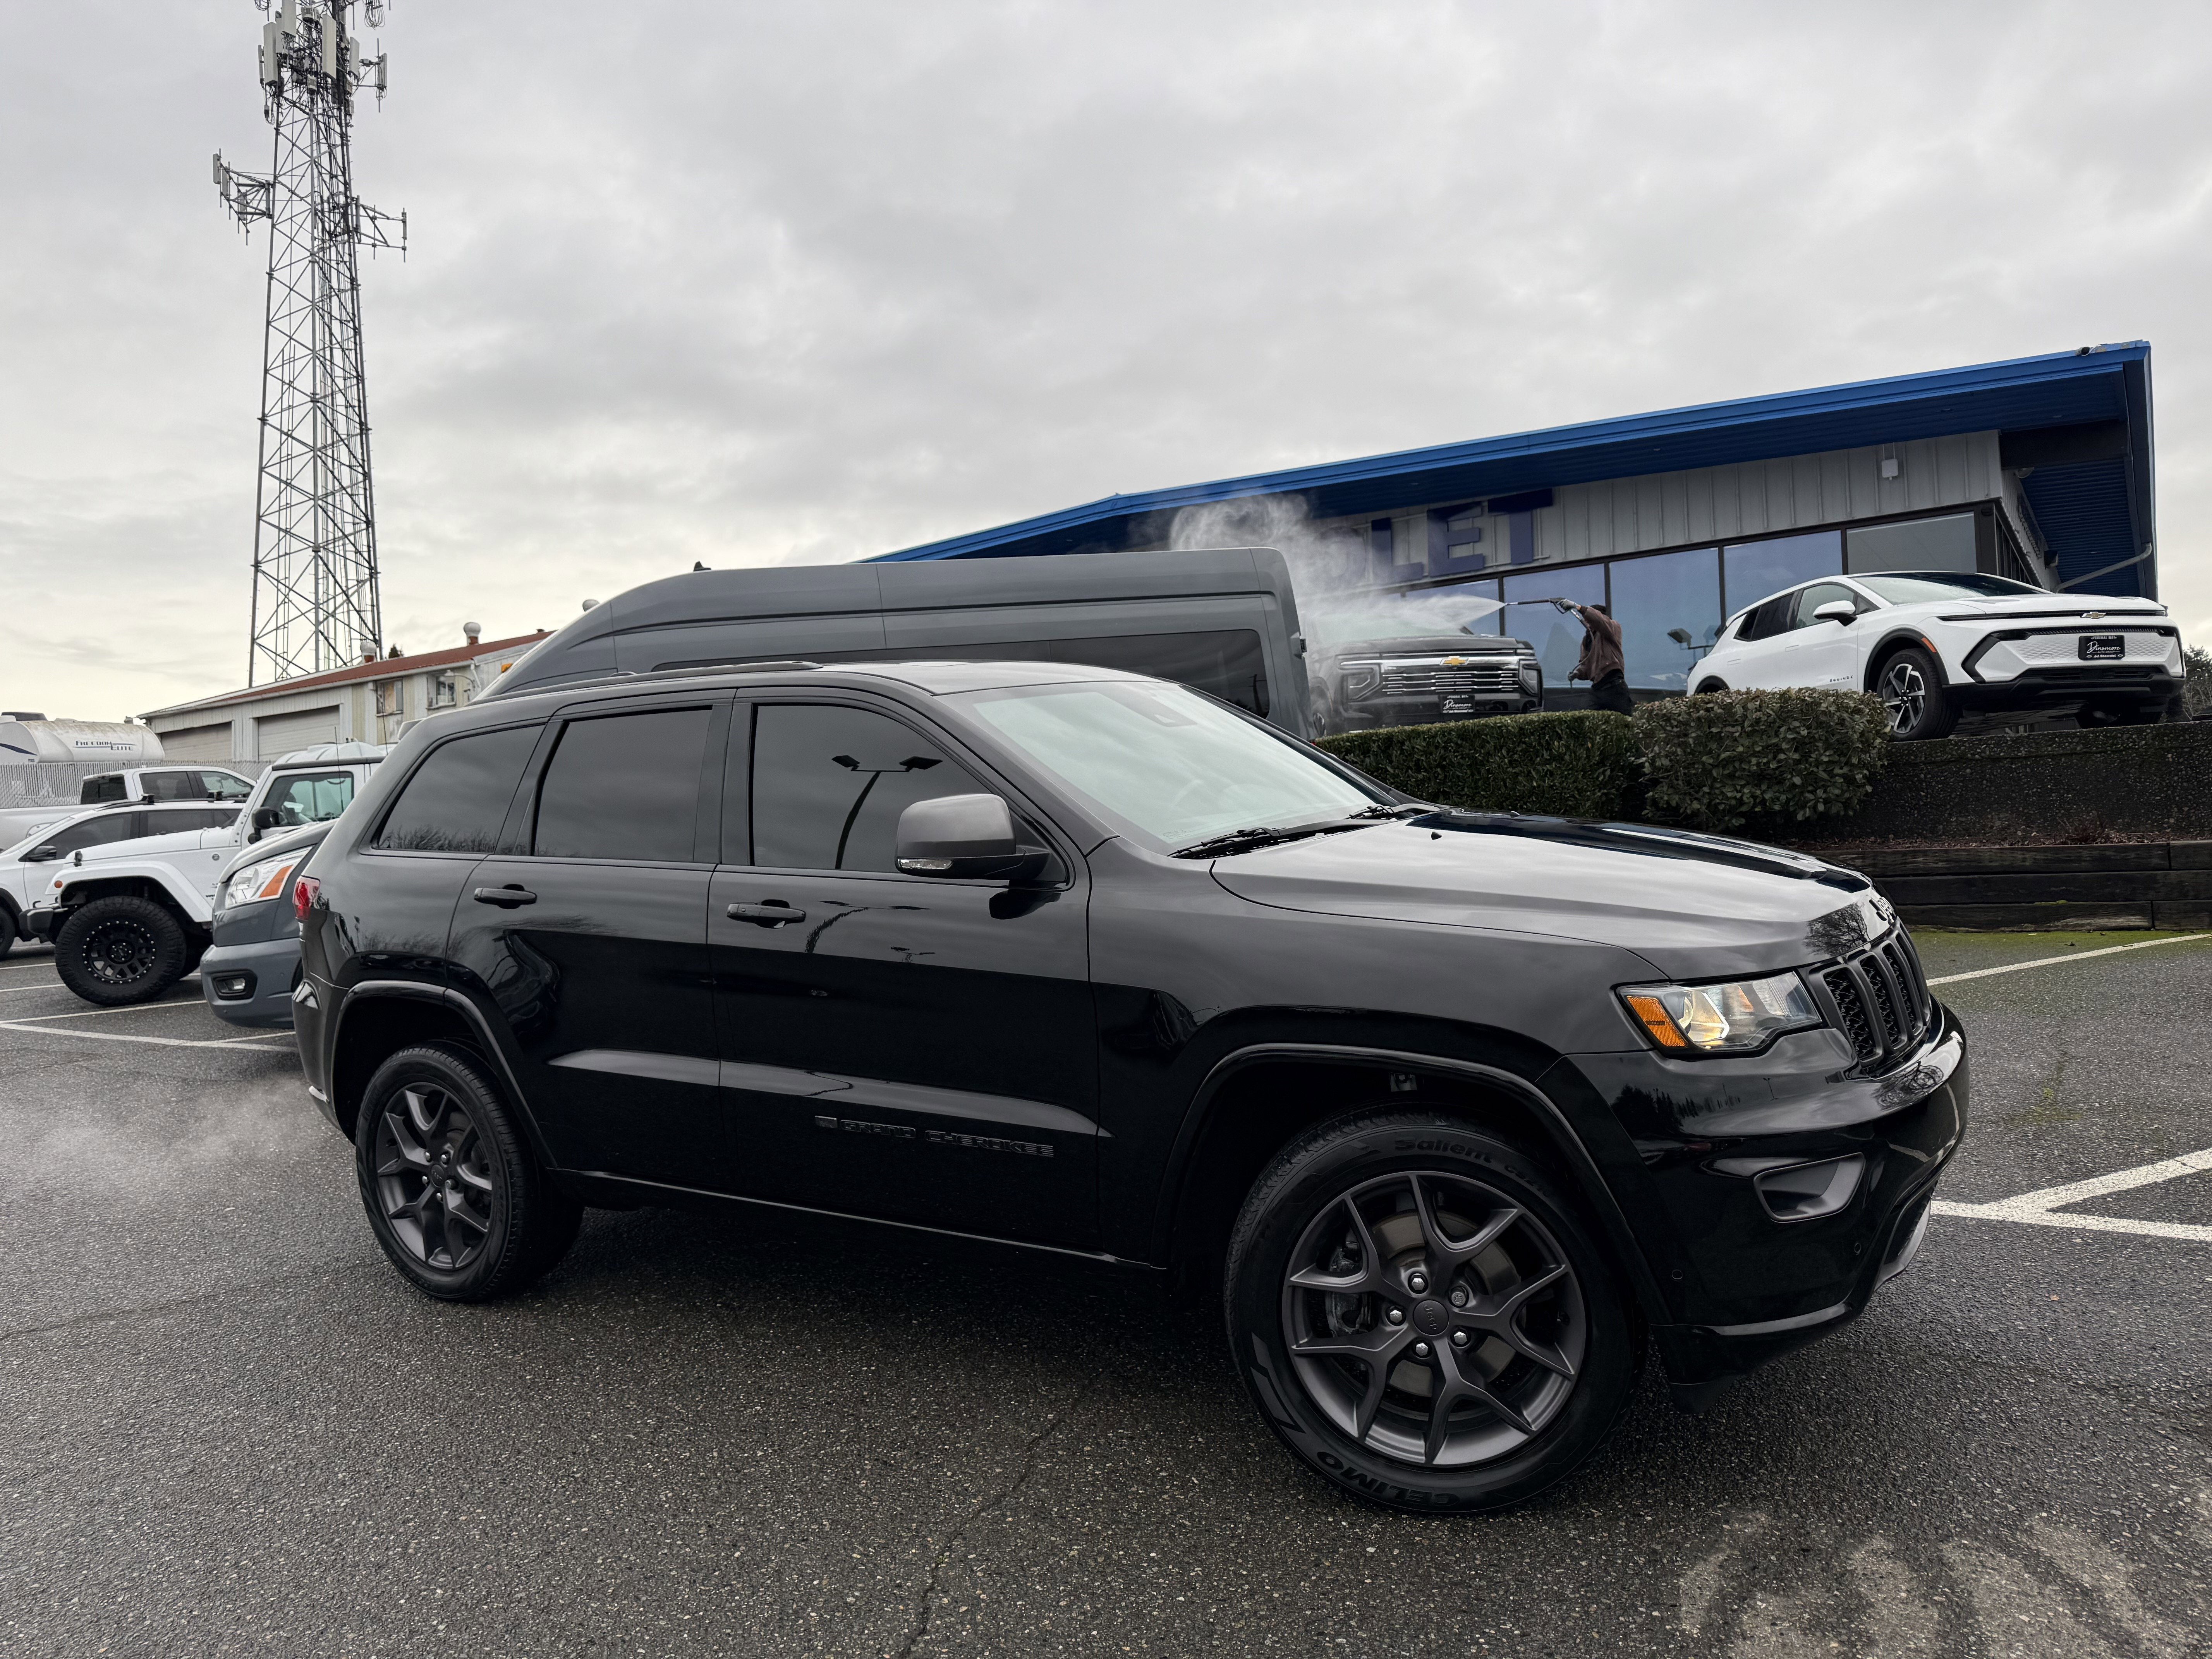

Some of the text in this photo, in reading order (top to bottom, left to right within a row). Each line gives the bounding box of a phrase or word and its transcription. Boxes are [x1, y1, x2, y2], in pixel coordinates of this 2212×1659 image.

[2087, 641, 2121, 653] Dinsmore
[840, 1119, 1054, 1158] GRAND CHEROKEE
[1424, 1304, 1437, 1329] Jeep
[1317, 1451, 1460, 1507] CELIMO
